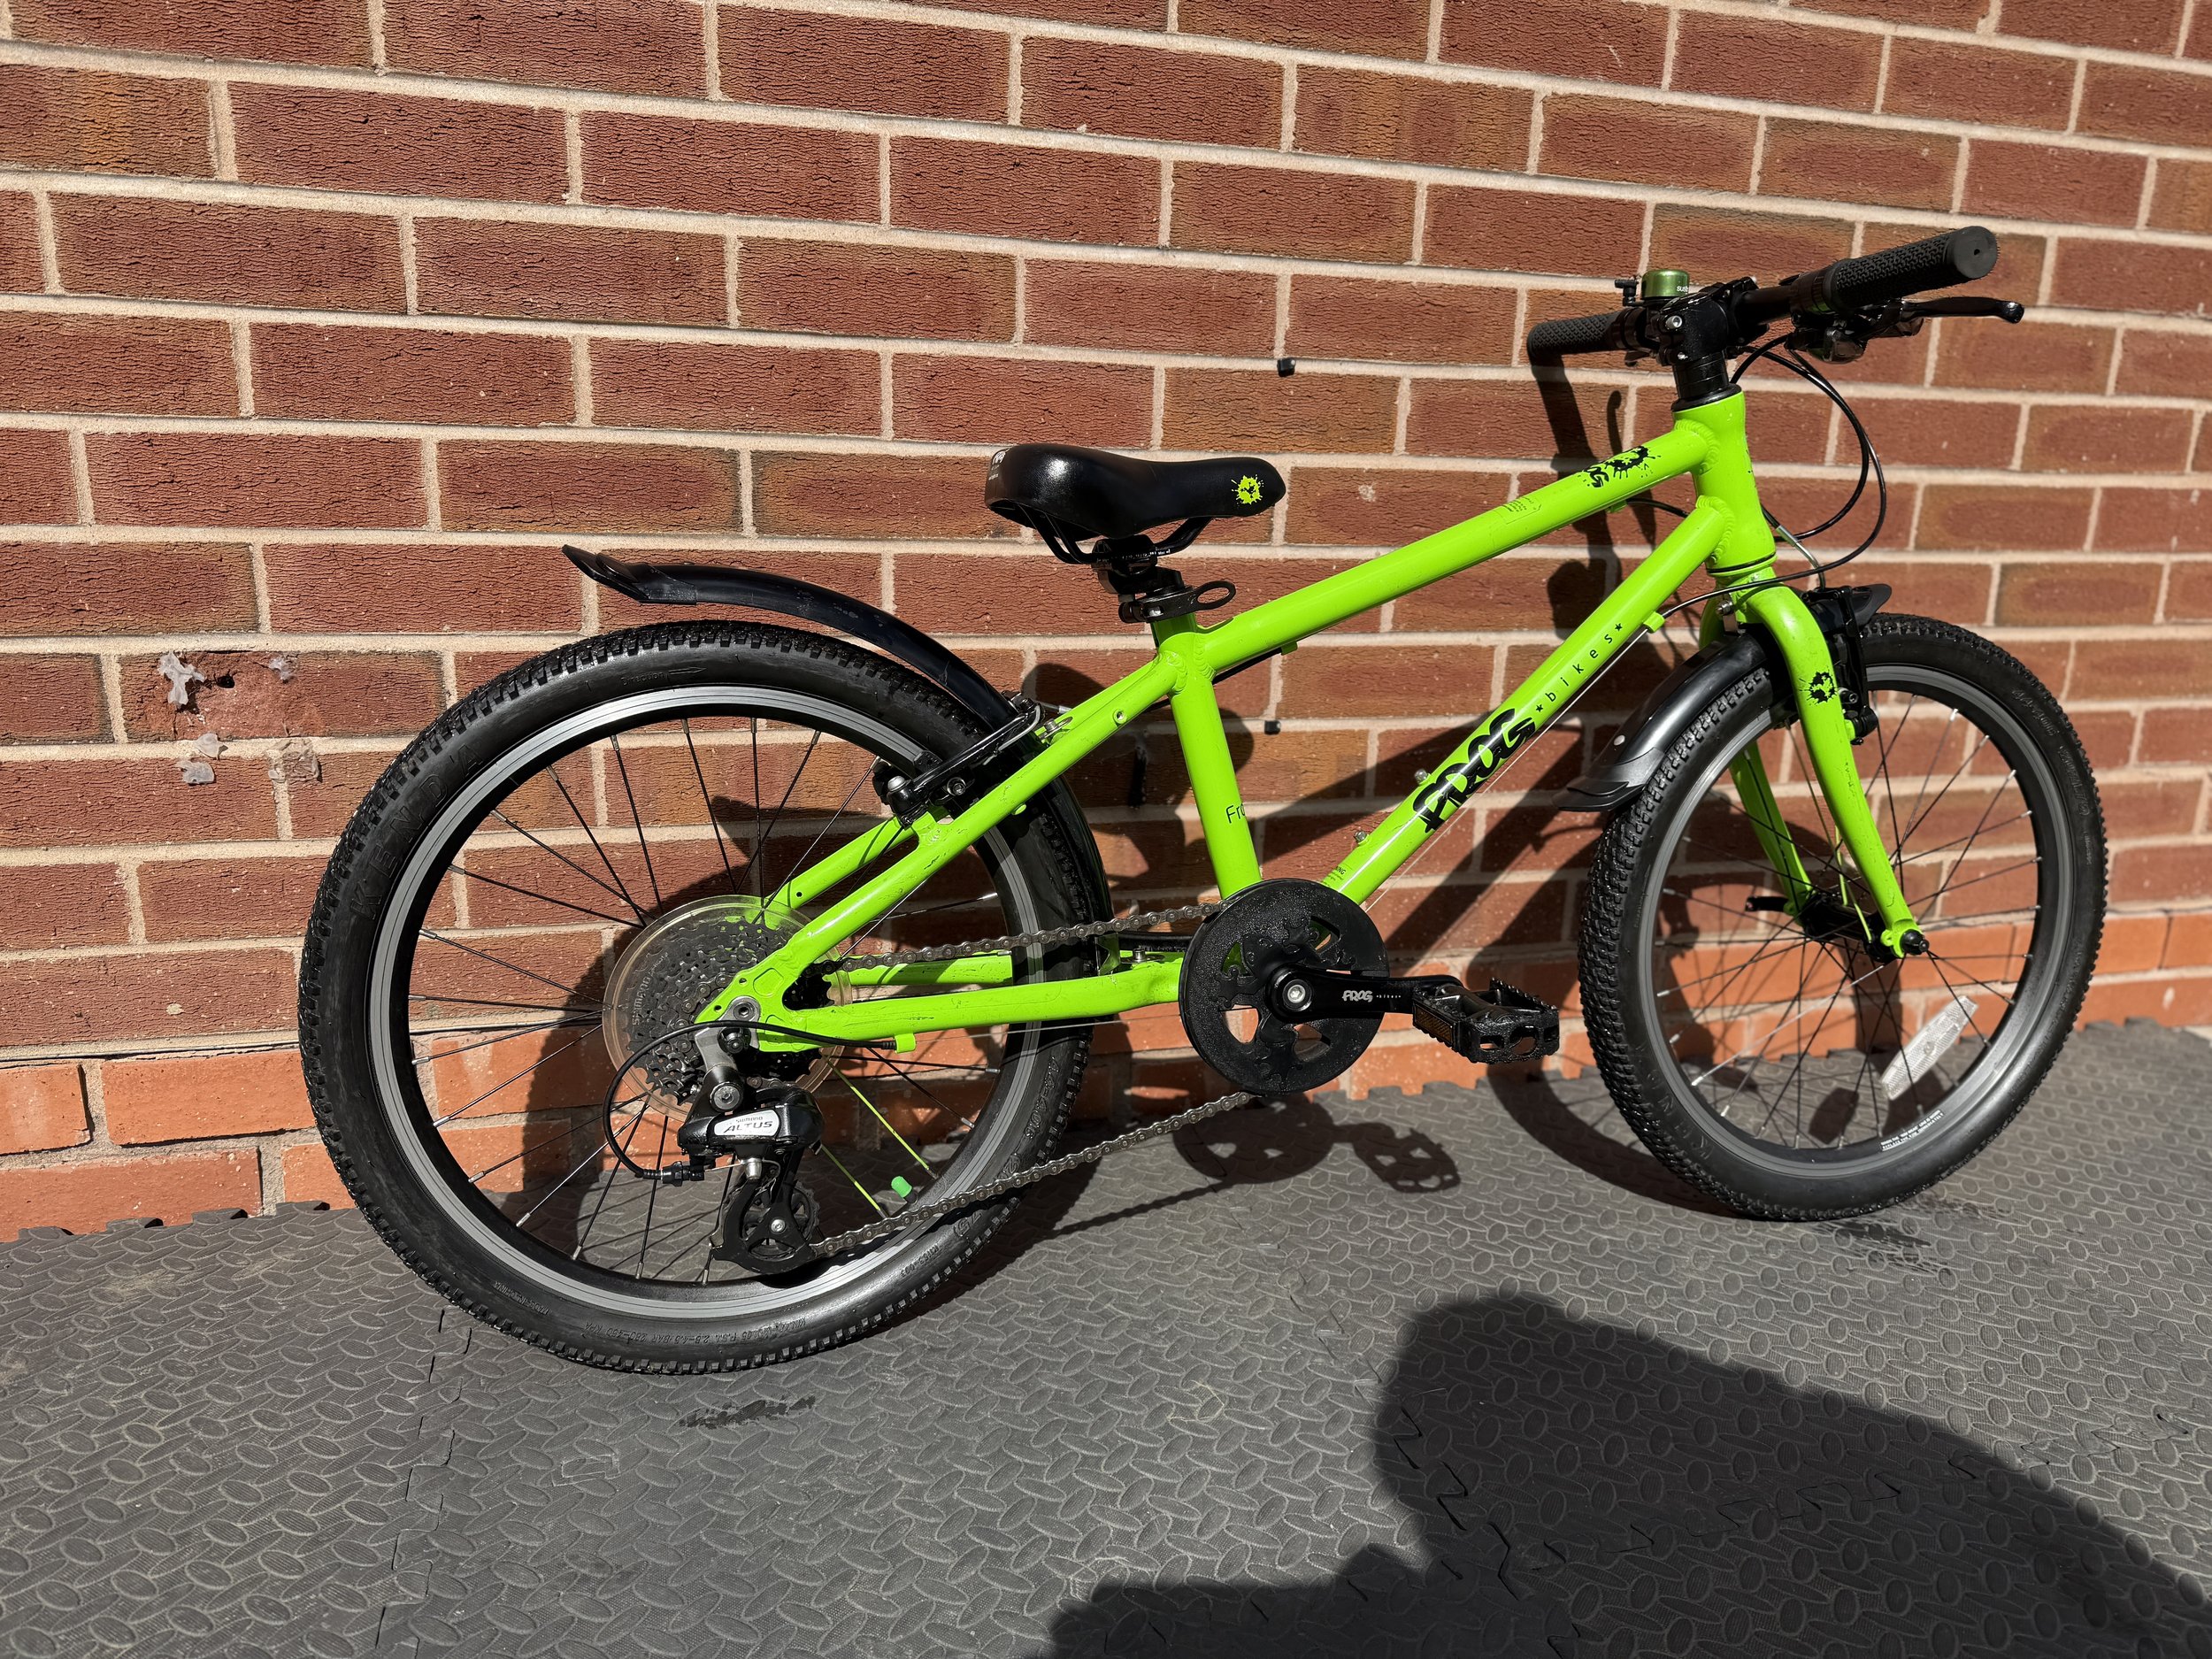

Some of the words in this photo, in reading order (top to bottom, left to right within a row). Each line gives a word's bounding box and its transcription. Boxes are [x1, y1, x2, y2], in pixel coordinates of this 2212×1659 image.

[1413, 708, 1536, 833] FROG
[1545, 634, 1614, 703] bikes
[351, 741, 483, 920] KENDA
[1341, 989, 1373, 1002] FROG
[723, 1120, 773, 1133] ALTUS
